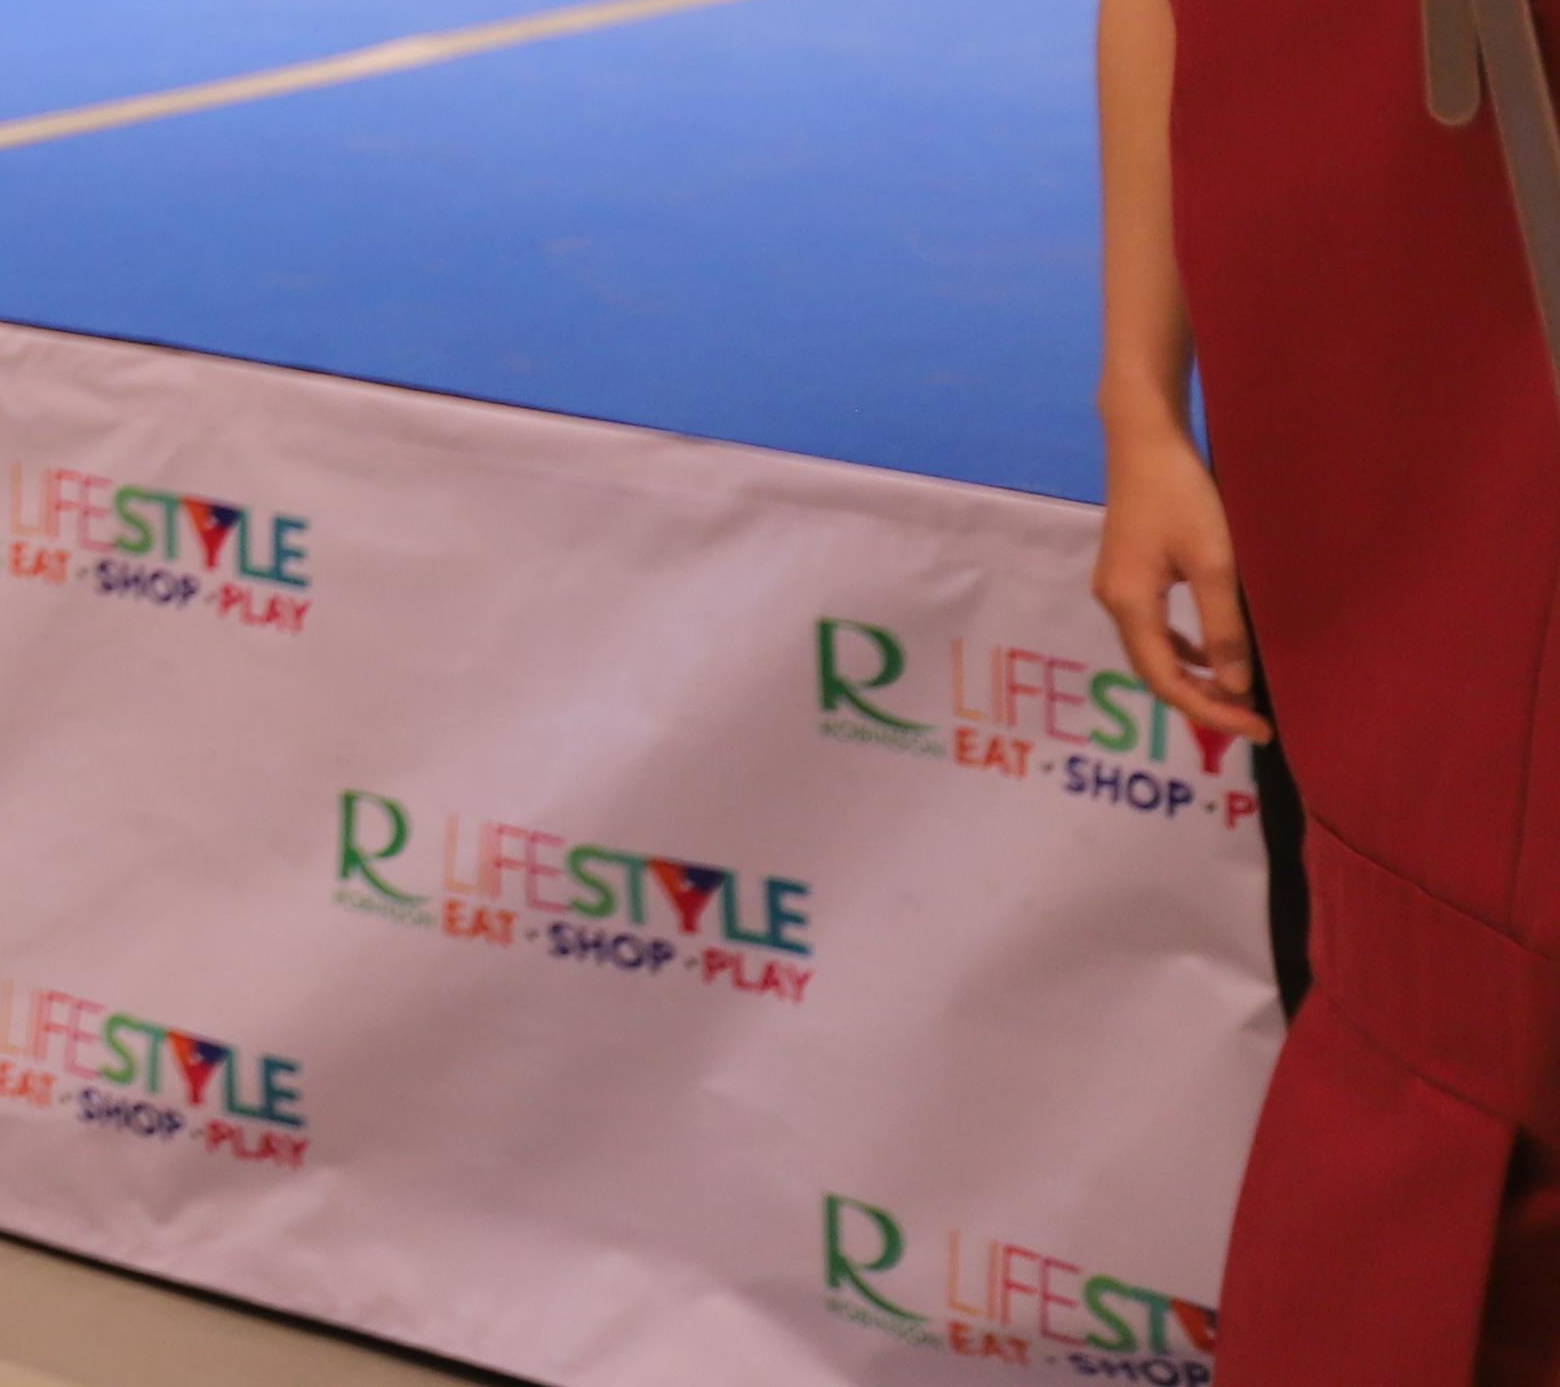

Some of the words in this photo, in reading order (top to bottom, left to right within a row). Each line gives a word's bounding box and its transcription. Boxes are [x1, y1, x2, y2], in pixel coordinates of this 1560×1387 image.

[10, 461, 310, 589] LIFESTYLE
[9, 541, 72, 586] EAT
[96, 559, 200, 607] SHOP
[219, 582, 311, 635] PLAY
[817, 617, 934, 729] R
[954, 726, 1034, 779] EAT
[1065, 755, 1192, 817] SHOP
[339, 789, 428, 904] R
[443, 811, 811, 956] LIFESTYLE
[442, 900, 516, 946] EAT
[547, 922, 675, 973] SHOP
[700, 946, 814, 1004] PLAY
[78, 1086, 184, 1140] SHOP
[205, 1118, 310, 1170] PLAY
[823, 1194, 926, 1322] R
[947, 1321, 1031, 1366] EAT
[1068, 1352, 1212, 1387] SHOP
